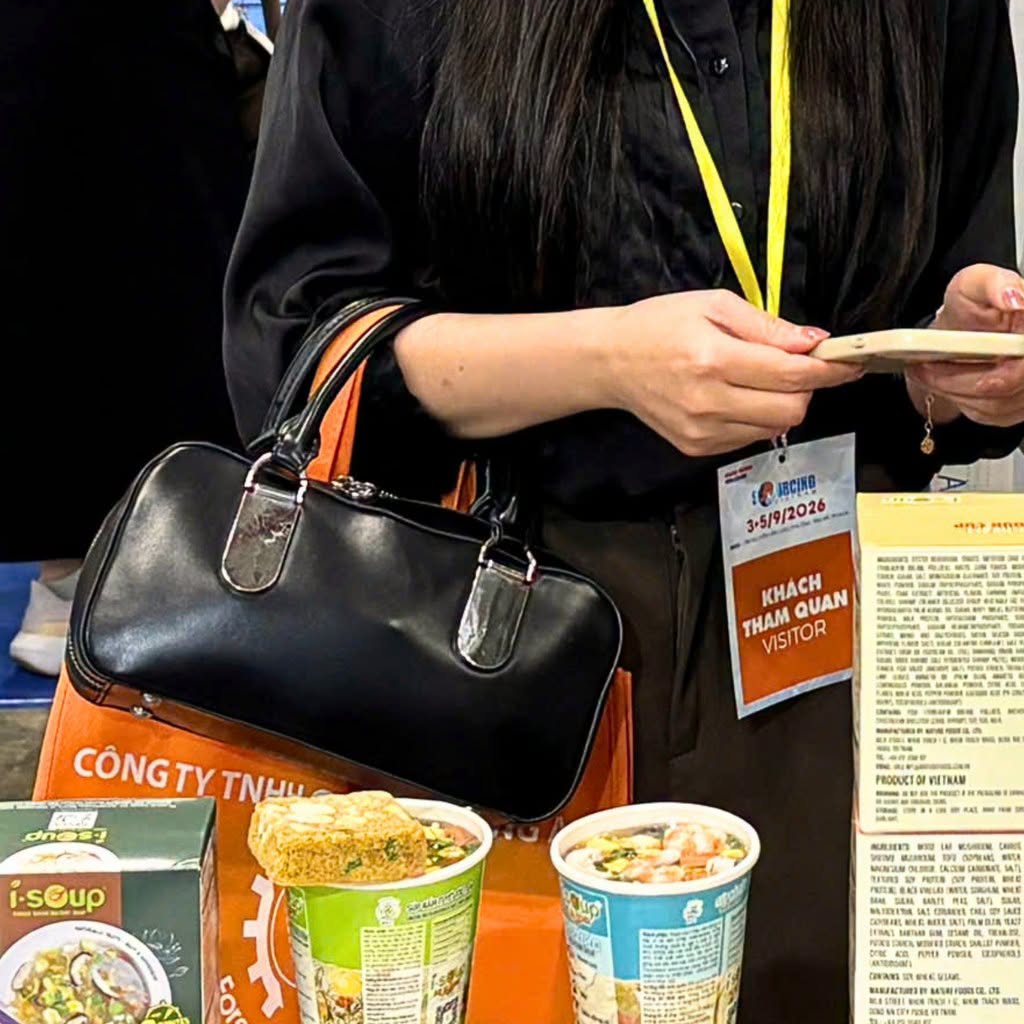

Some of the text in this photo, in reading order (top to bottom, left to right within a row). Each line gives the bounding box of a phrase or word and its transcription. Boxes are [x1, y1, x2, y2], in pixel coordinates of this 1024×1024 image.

[761, 572, 822, 608] KHÁCH
[742, 606, 791, 639] THAM
[794, 588, 849, 620] QUAN
[761, 618, 827, 655] VISITOR
[73, 745, 170, 789] CÔNG
[174, 762, 217, 797] TY
[875, 774, 967, 787] PRODUCT OF VIETNAM
